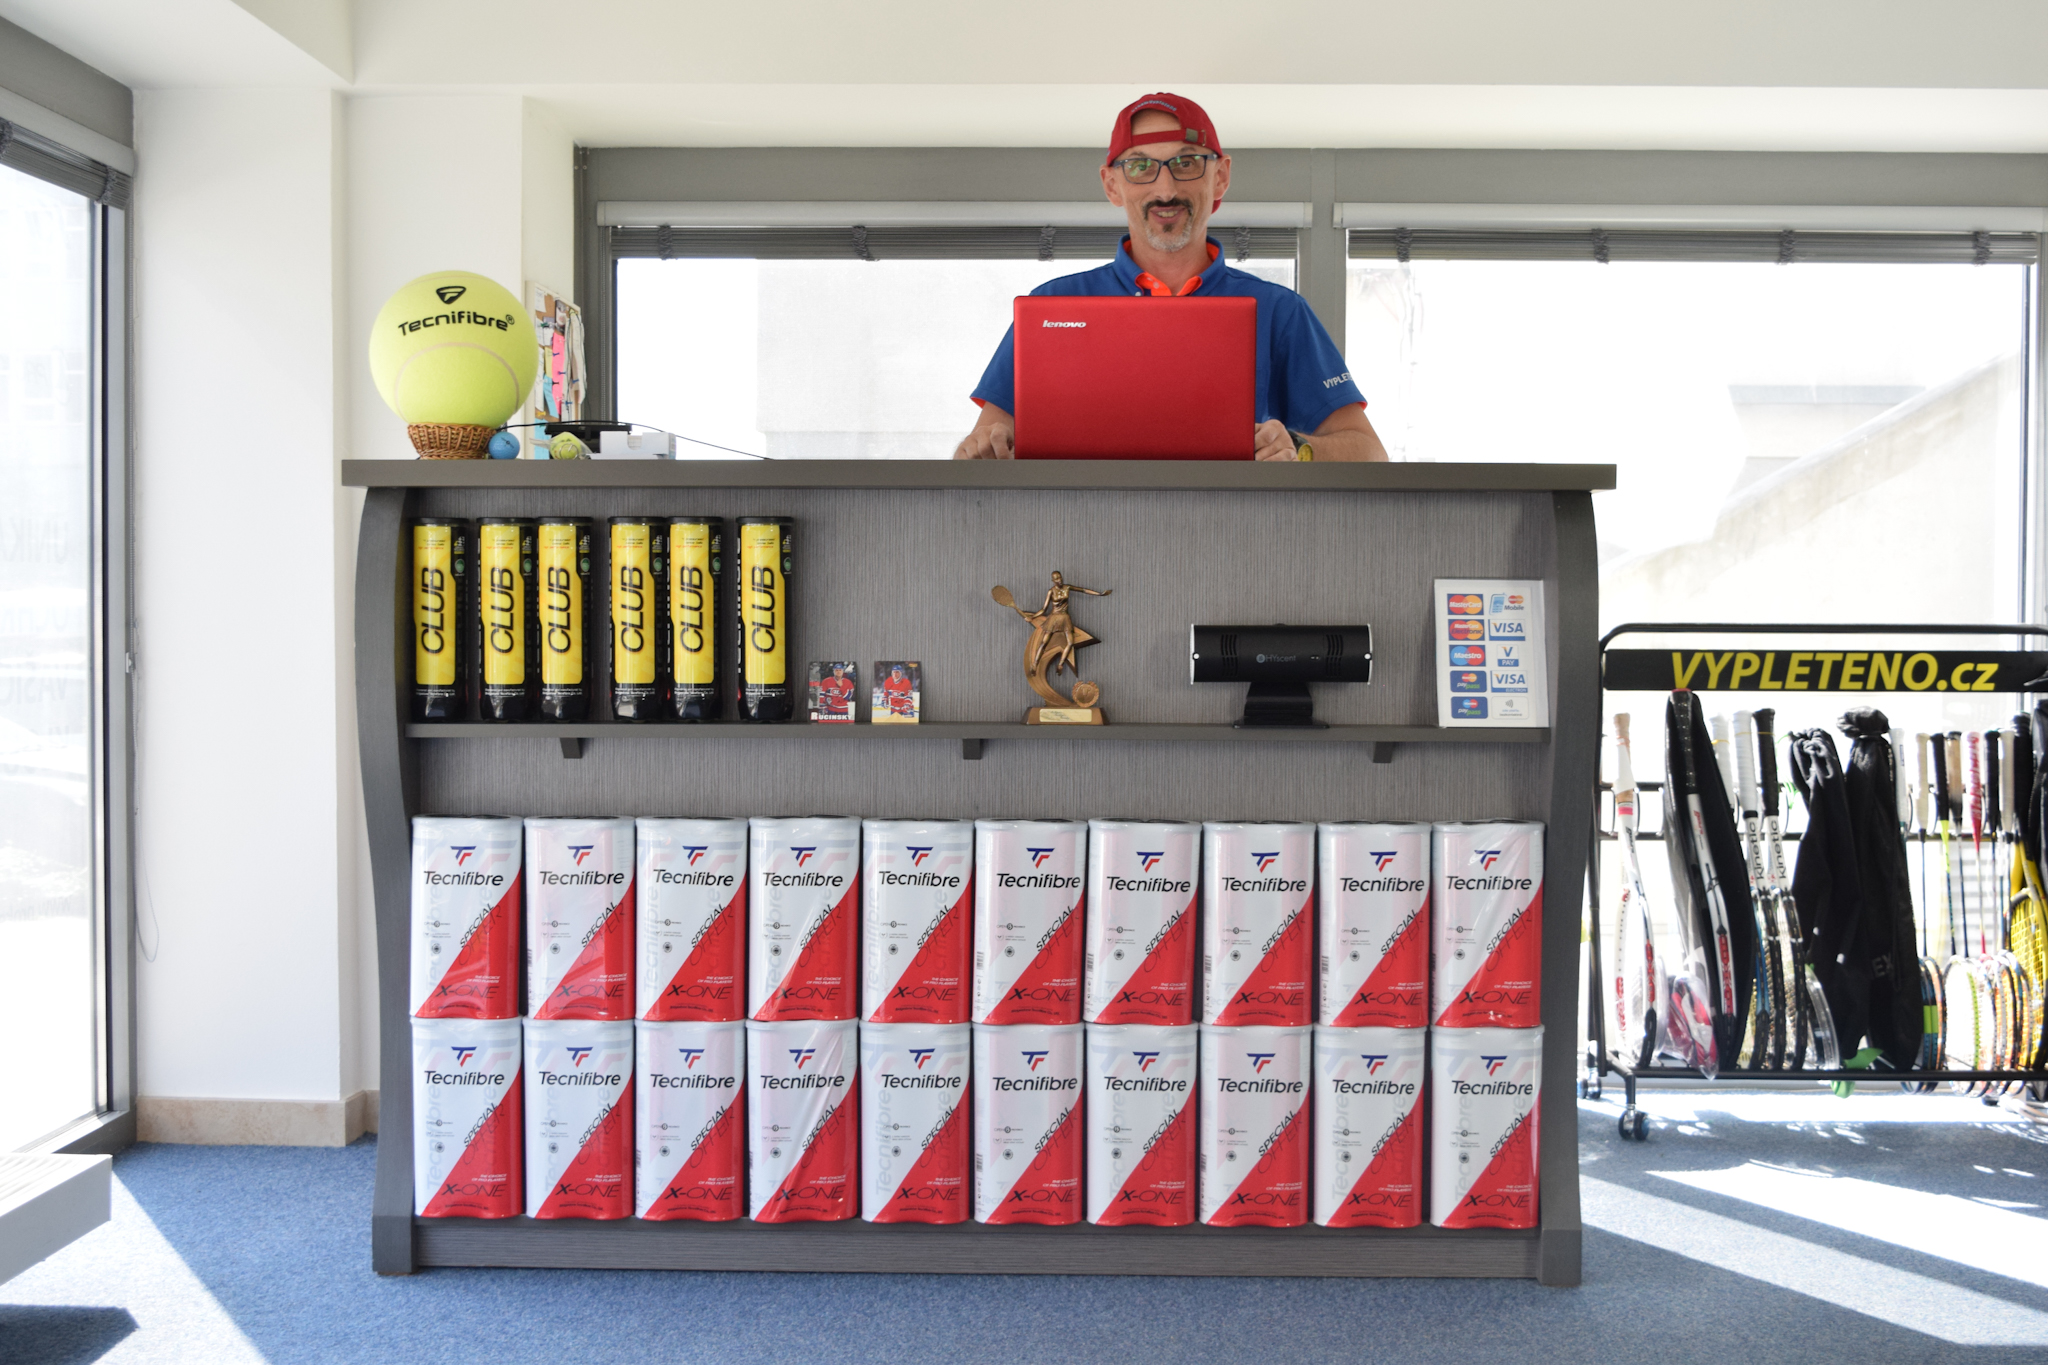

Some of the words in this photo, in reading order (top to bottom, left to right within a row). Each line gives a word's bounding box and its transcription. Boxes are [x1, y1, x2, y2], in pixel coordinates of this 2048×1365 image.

[1042, 319, 1087, 329] lenovo
[421, 566, 445, 654] CLUB
[490, 566, 514, 654] CLUB
[548, 566, 571, 654] CLUB
[620, 565, 644, 652] CLUB
[680, 565, 703, 652] CLUB
[752, 566, 775, 653] CLUB
[1492, 622, 1523, 633] VISA
[1502, 646, 1513, 657] V
[1494, 674, 1525, 684] VISA
[1672, 652, 1999, 690] VYPLETENO.cz
[424, 870, 504, 887] Tecnifibre
[539, 870, 625, 885] Tecnifibre
[653, 869, 734, 887] Tecnifibre
[763, 872, 844, 888] Tecnifibre
[878, 870, 961, 888] Tecnifibre
[997, 873, 1081, 889] Tecnifibre
[1106, 876, 1191, 893] Tecnifibre
[1221, 876, 1307, 893] Tecnifibre
[1340, 877, 1425, 893] Tecnifibre
[1446, 875, 1533, 891] Tecnifibre
[460, 903, 495, 948] SPECIAL
[581, 902, 618, 948] SPECIAL
[691, 904, 725, 948] SPECIAL
[800, 904, 834, 949] SPECIAL
[917, 905, 951, 949] SPECIAL
[1037, 906, 1074, 952] SPECIAL
[1145, 910, 1182, 955] SPECIAL
[1262, 909, 1299, 955] SPECIAL
[1381, 909, 1417, 955] SPECIAL
[1487, 908, 1524, 954] SPECIAL
[436, 984, 499, 999] X-ONE
[556, 983, 627, 998] X-ONE
[667, 984, 733, 1000] X-ONE
[776, 987, 841, 1000] X-ONE
[893, 986, 957, 1001] X-ONE
[1008, 988, 1076, 1002] X-ONE
[1117, 991, 1187, 1006] X-ONE
[1355, 991, 1423, 1006] X-ONE
[1460, 991, 1531, 1005] X-ONE
[1235, 992, 1304, 1006] X-ONE
[424, 1070, 505, 1086] Tecnifibre
[538, 1071, 622, 1086] Tecnifibre
[650, 1073, 736, 1089] Tecnifibre
[760, 1073, 846, 1090] Tecnifibre
[881, 1074, 962, 1089] Tecnifibre
[992, 1076, 1078, 1092] Tecnifibre
[1104, 1076, 1187, 1092] Tecnifibre
[1217, 1077, 1304, 1094] Tecnifibre
[1332, 1079, 1415, 1095] Tecnifibre
[1451, 1080, 1533, 1096] Tecnifibre
[464, 1102, 498, 1147] SPECIAL
[579, 1103, 614, 1148] SPECIAL
[691, 1105, 728, 1150] SPECIAL
[802, 1104, 837, 1150] SPECIAL
[921, 1106, 955, 1150] SPECIAL
[1035, 1107, 1072, 1153] SPECIAL
[1143, 1109, 1179, 1154] SPECIAL
[1259, 1111, 1296, 1157] SPECIAL
[1372, 1112, 1407, 1156] SPECIAL
[1490, 1113, 1525, 1158] SPECIAL
[441, 1184, 506, 1197] X-ONE
[556, 1184, 622, 1198] X-ONE
[665, 1187, 734, 1201] X-ONE
[777, 1186, 846, 1201] X-ONE
[897, 1187, 961, 1201] X-ONE
[1009, 1189, 1077, 1203] X-ONE
[1119, 1190, 1185, 1204] X-ONE
[1231, 1193, 1301, 1206] X-ONE
[1348, 1193, 1412, 1207] X-ONE
[1465, 1194, 1530, 1208] X-ONE
